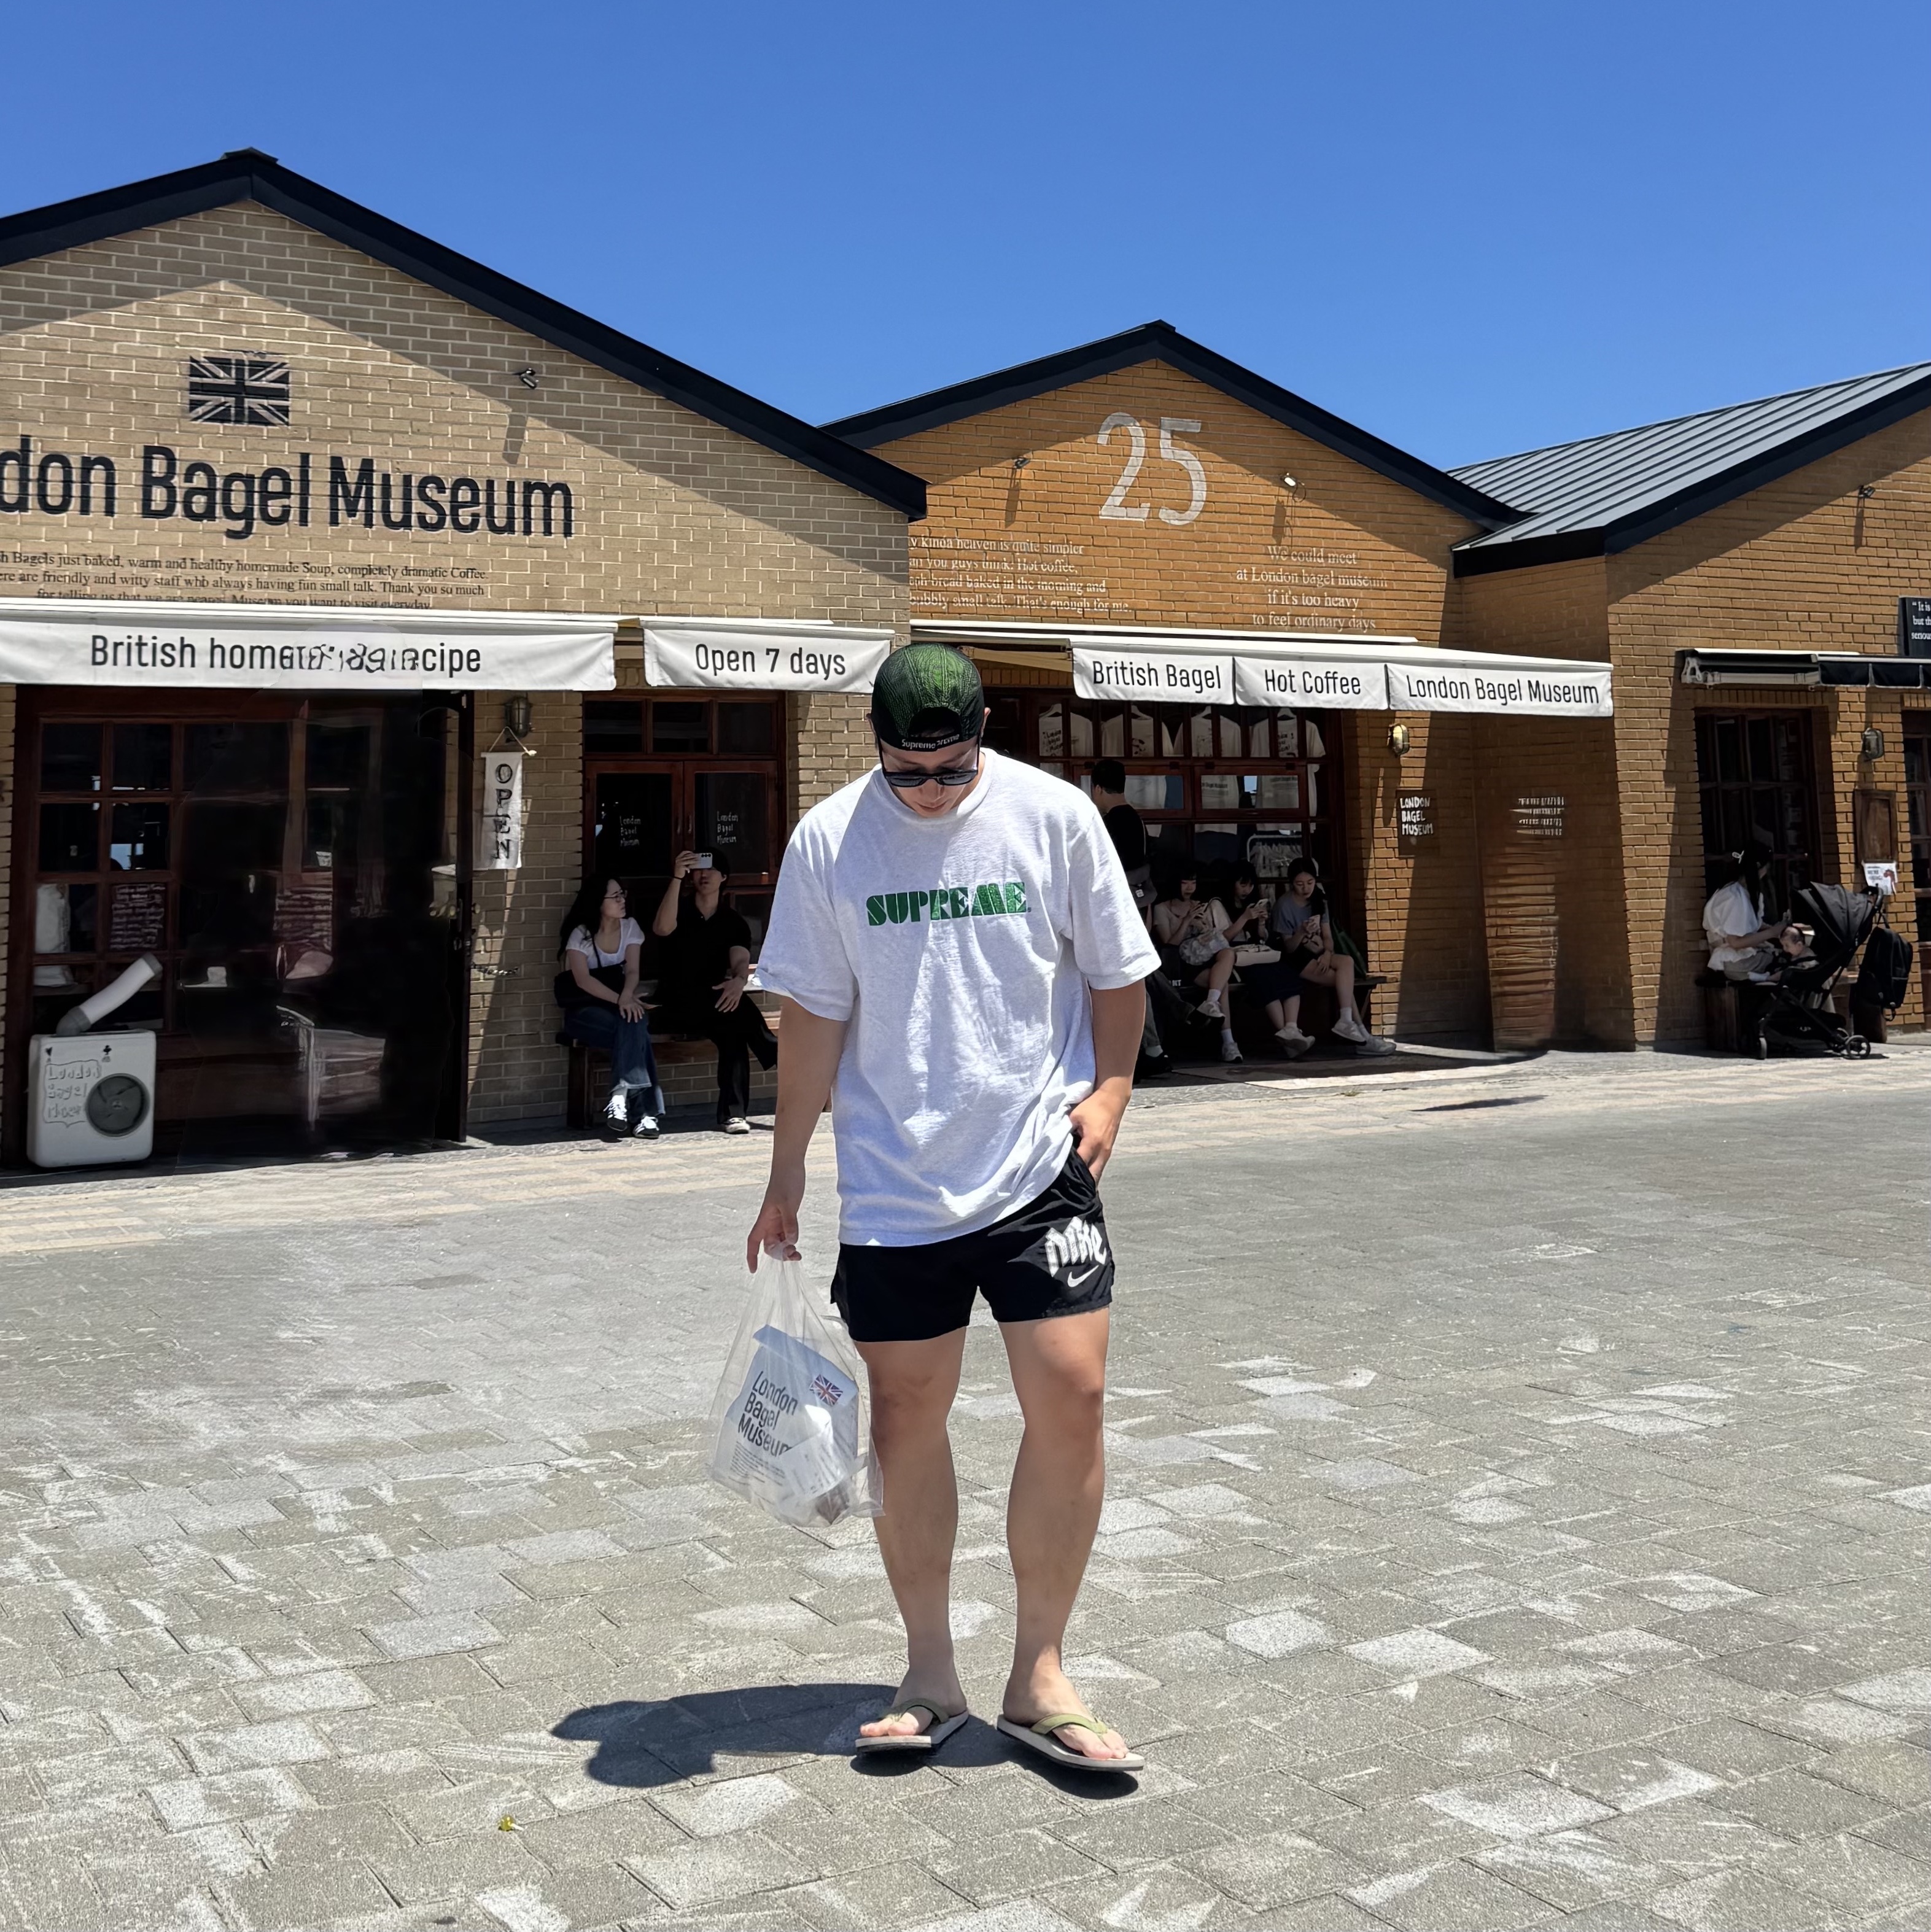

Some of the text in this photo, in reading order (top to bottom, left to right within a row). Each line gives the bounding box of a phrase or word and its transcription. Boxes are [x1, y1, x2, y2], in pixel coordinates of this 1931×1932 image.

[1097, 412, 1206, 526] 25
[142, 444, 309, 539] Bagel
[328, 456, 574, 538] Museum
[922, 535, 953, 548] kinda
[957, 538, 997, 551] heaven
[1000, 538, 1009, 551] is
[1012, 539, 1039, 555] quite
[1044, 540, 1083, 556] simpler
[1267, 545, 1358, 564] We could meet
[13, 552, 55, 566] Bagels
[57, 553, 80, 567] just
[84, 554, 124, 568] baked,
[128, 559, 161, 568] warm
[165, 558, 187, 569] and
[190, 558, 233, 573] healthy
[237, 560, 299, 573] homemade
[303, 562, 335, 577] Soup,
[338, 564, 398, 578] completely
[401, 566, 448, 578] dramatic
[451, 567, 489, 578] Coffee.
[927, 558, 947, 570] you
[952, 559, 978, 571] guys
[982, 557, 1013, 571] think.
[1017, 558, 1038, 572] Hot
[1041, 559, 1078, 575] coffee,
[18, 573, 39, 582] are
[43, 572, 90, 586] friendly
[94, 572, 116, 584] and
[119, 574, 150, 588] witty
[154, 575, 182, 586] staff
[184, 576, 209, 587] who
[212, 577, 252, 589] always
[256, 578, 295, 592] having
[298, 579, 316, 590] fun
[320, 580, 350, 591] small
[354, 581, 377, 592] talk.
[380, 581, 414, 593] Thank
[418, 585, 437, 596] you
[456, 585, 484, 595] much
[931, 573, 962, 587] bread
[966, 575, 999, 589] baked
[1003, 576, 1014, 589] in
[1017, 576, 1035, 590] the
[1038, 578, 1083, 596] morning
[1086, 580, 1106, 592] and
[1236, 567, 1388, 588] at London bagel museum
[952, 594, 983, 607] small
[986, 594, 1011, 608] talk.
[1014, 595, 1046, 608] That's
[1051, 598, 1090, 614] enough
[1094, 599, 1109, 611] for
[1113, 602, 1132, 612] me.
[1268, 589, 1359, 611] if it's too heavy
[1253, 611, 1376, 632] to feel ordinary days
[1912, 615, 1924, 625] but
[91, 635, 196, 669] British
[695, 643, 845, 681] Open 7 days
[1092, 661, 1221, 693] British Bagel
[1265, 669, 1361, 696] Hot Coffee
[1406, 675, 1599, 706] London Bagel Museum
[901, 739, 936, 750] Supreme
[1400, 796, 1431, 809] LONDON
[1401, 810, 1426, 823] BAGEL
[1402, 823, 1434, 836] MUSEUM
[866, 882, 1027, 926] SUPREME
[752, 1370, 798, 1416] London
[744, 1391, 780, 1430] Bagel
